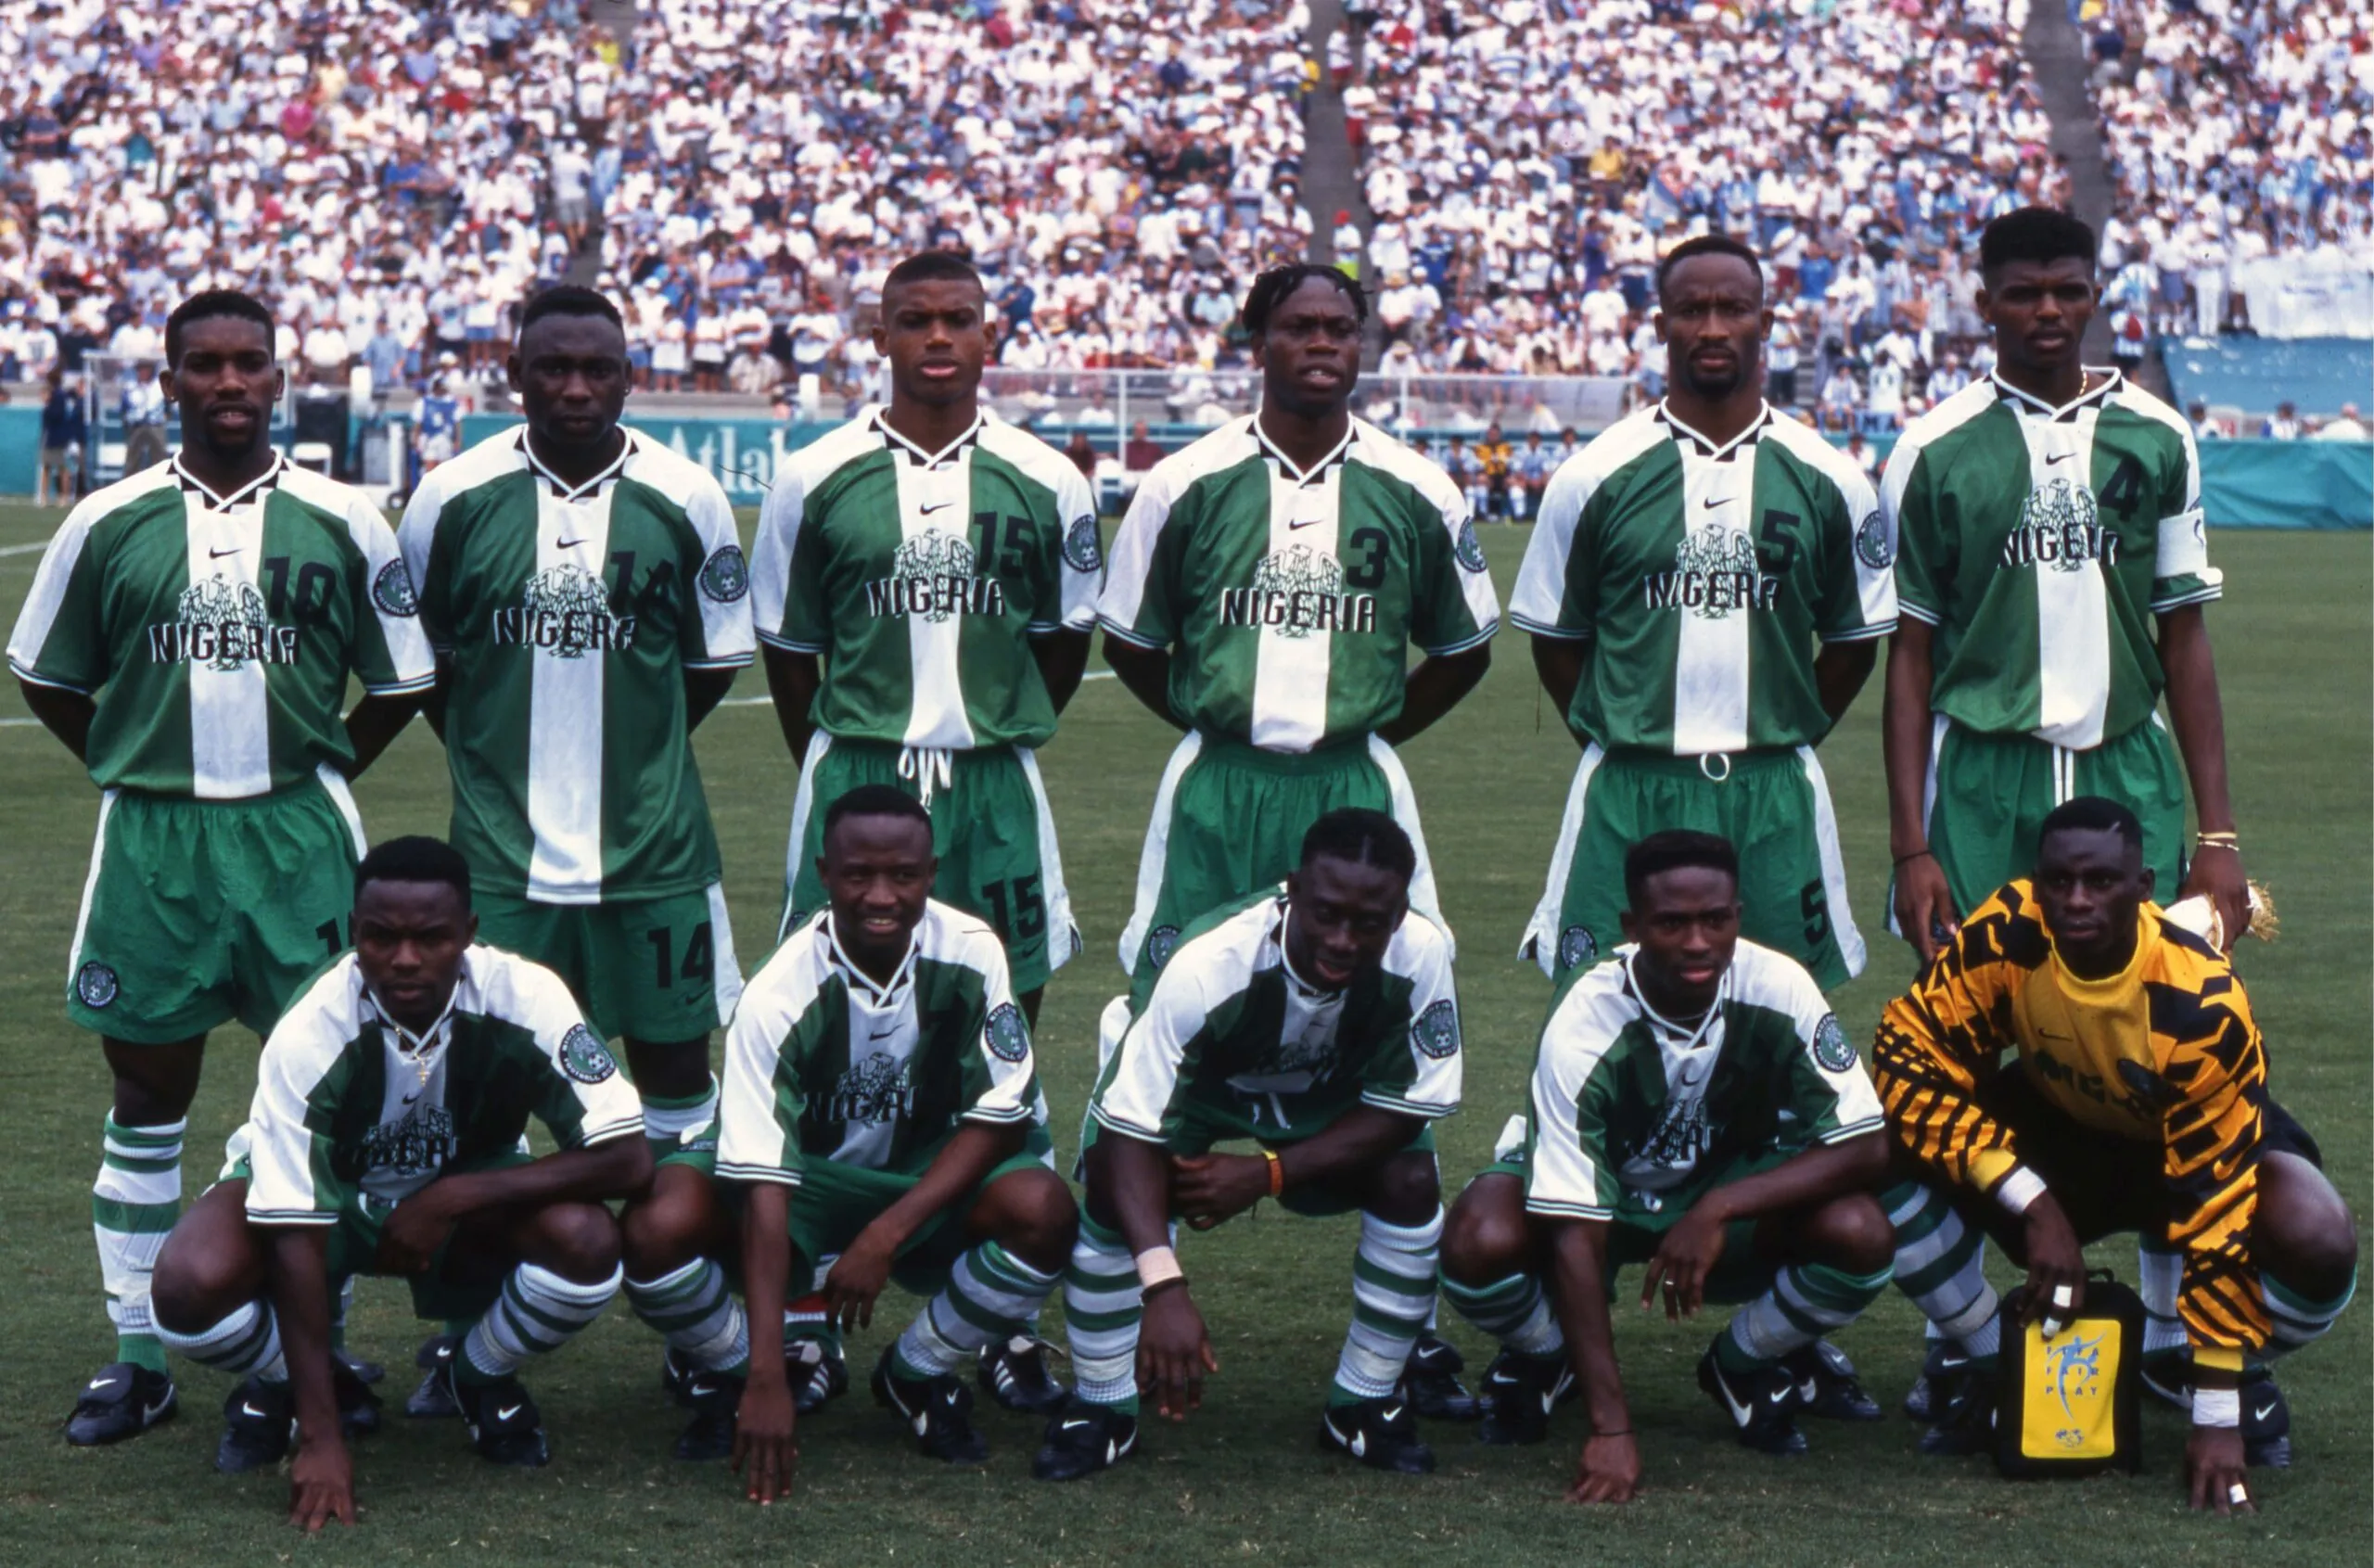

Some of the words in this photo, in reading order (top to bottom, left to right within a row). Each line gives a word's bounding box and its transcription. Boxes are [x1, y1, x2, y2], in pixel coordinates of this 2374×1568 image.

[2099, 456, 2140, 522] 4
[974, 512, 1036, 577] 15
[1346, 527, 1390, 589] 3
[1756, 508, 1801, 573] 5
[263, 555, 337, 624] 10
[865, 574, 1006, 618] NIGERIA
[1219, 587, 1377, 634] NIGERIA
[148, 620, 300, 666] NIGERIA
[315, 912, 356, 958] 1
[981, 873, 1046, 944] 15
[1800, 879, 1829, 946] 5
[647, 920, 715, 988] 14
[2046, 1366, 2100, 1376] FAIR
[2046, 1385, 2098, 1396] PLAY
